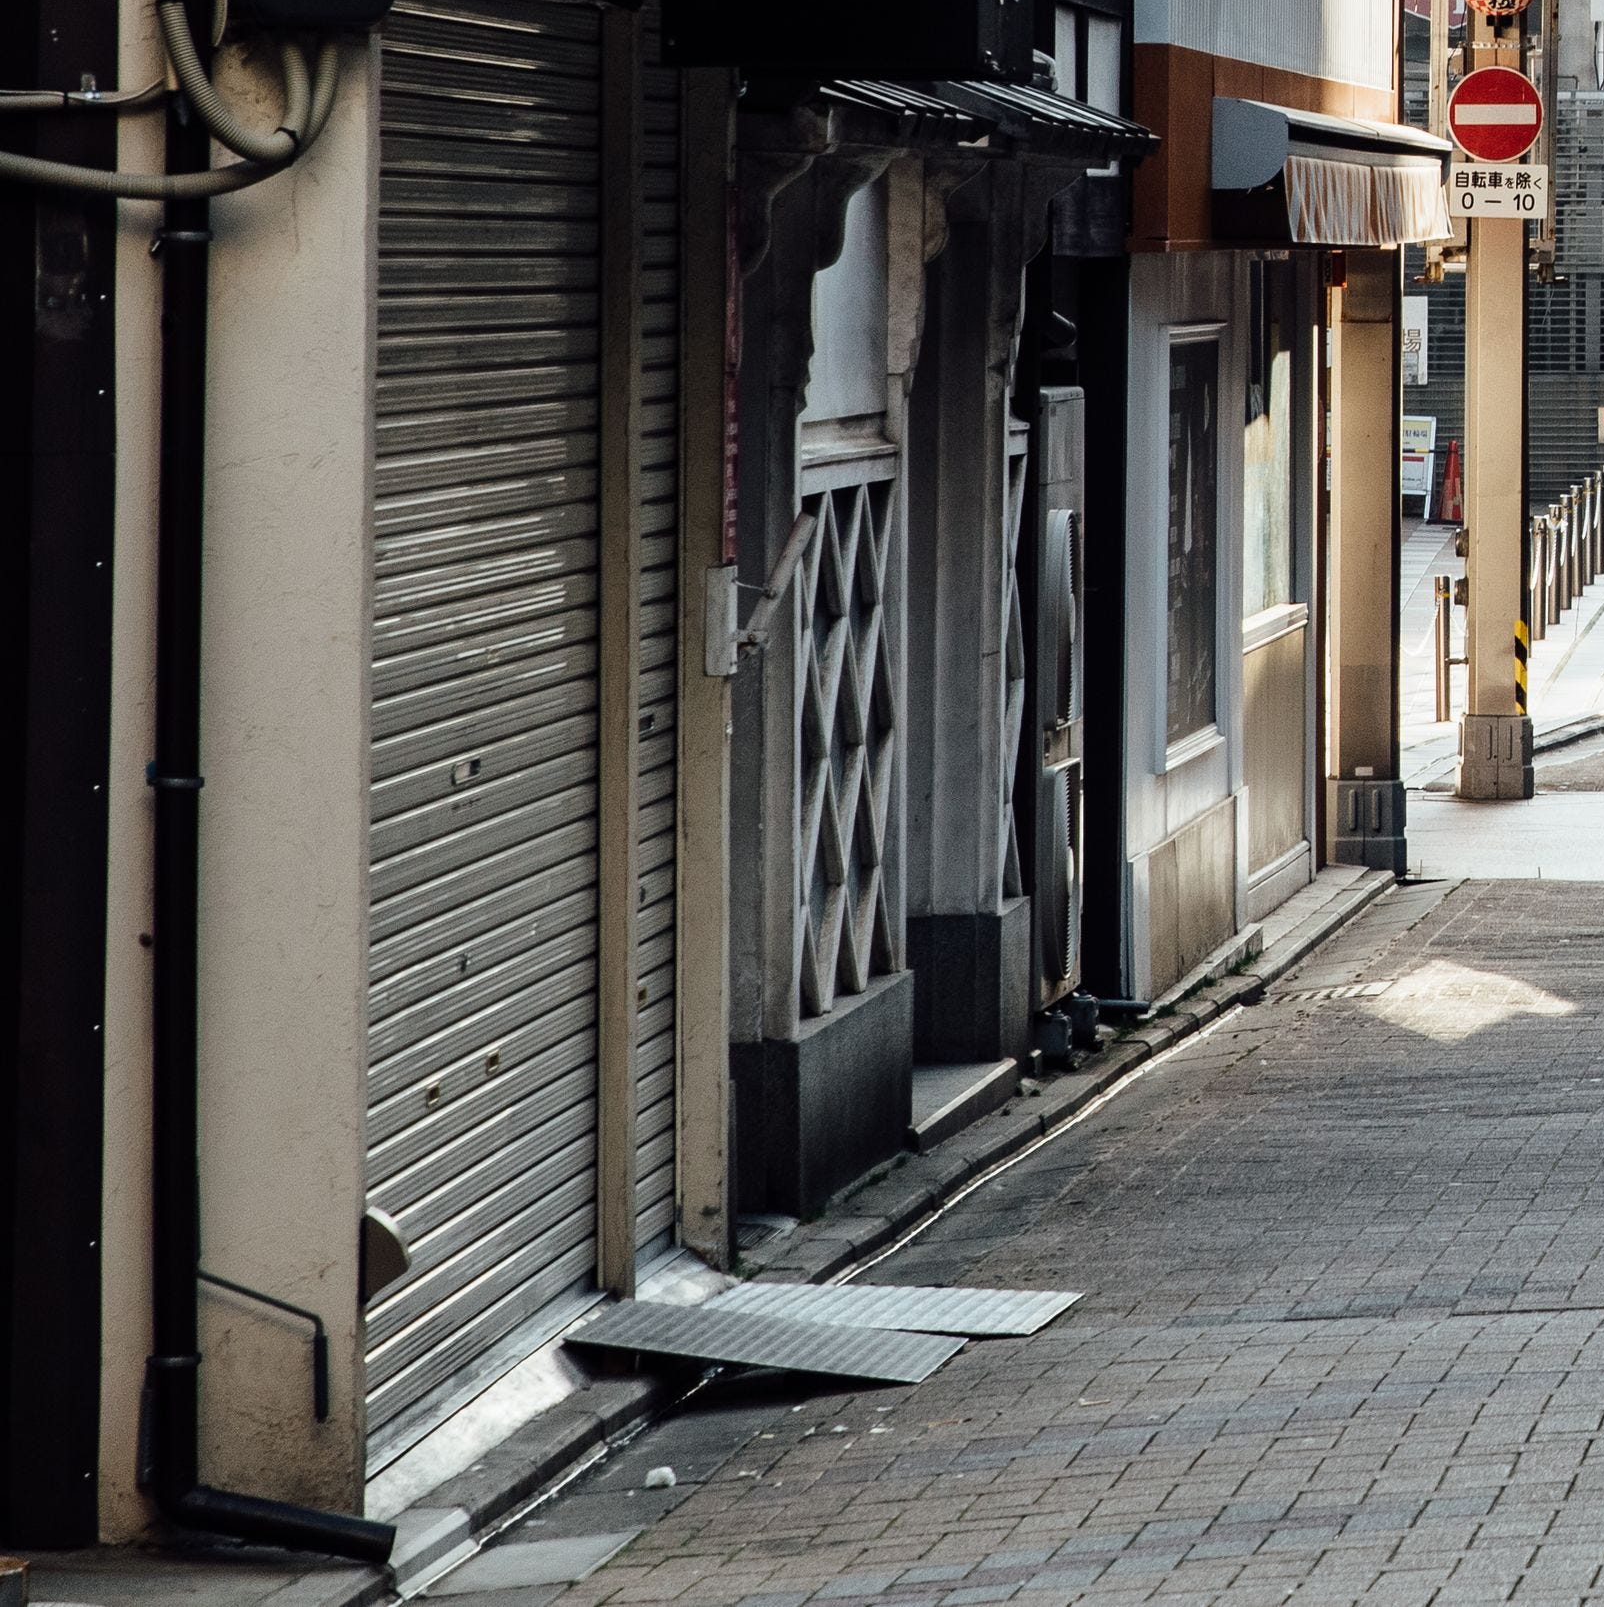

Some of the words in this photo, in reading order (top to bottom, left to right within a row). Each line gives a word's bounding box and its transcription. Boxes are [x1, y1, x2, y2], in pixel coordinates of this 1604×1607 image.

[1455, 170, 1542, 190] 自転車を除く
